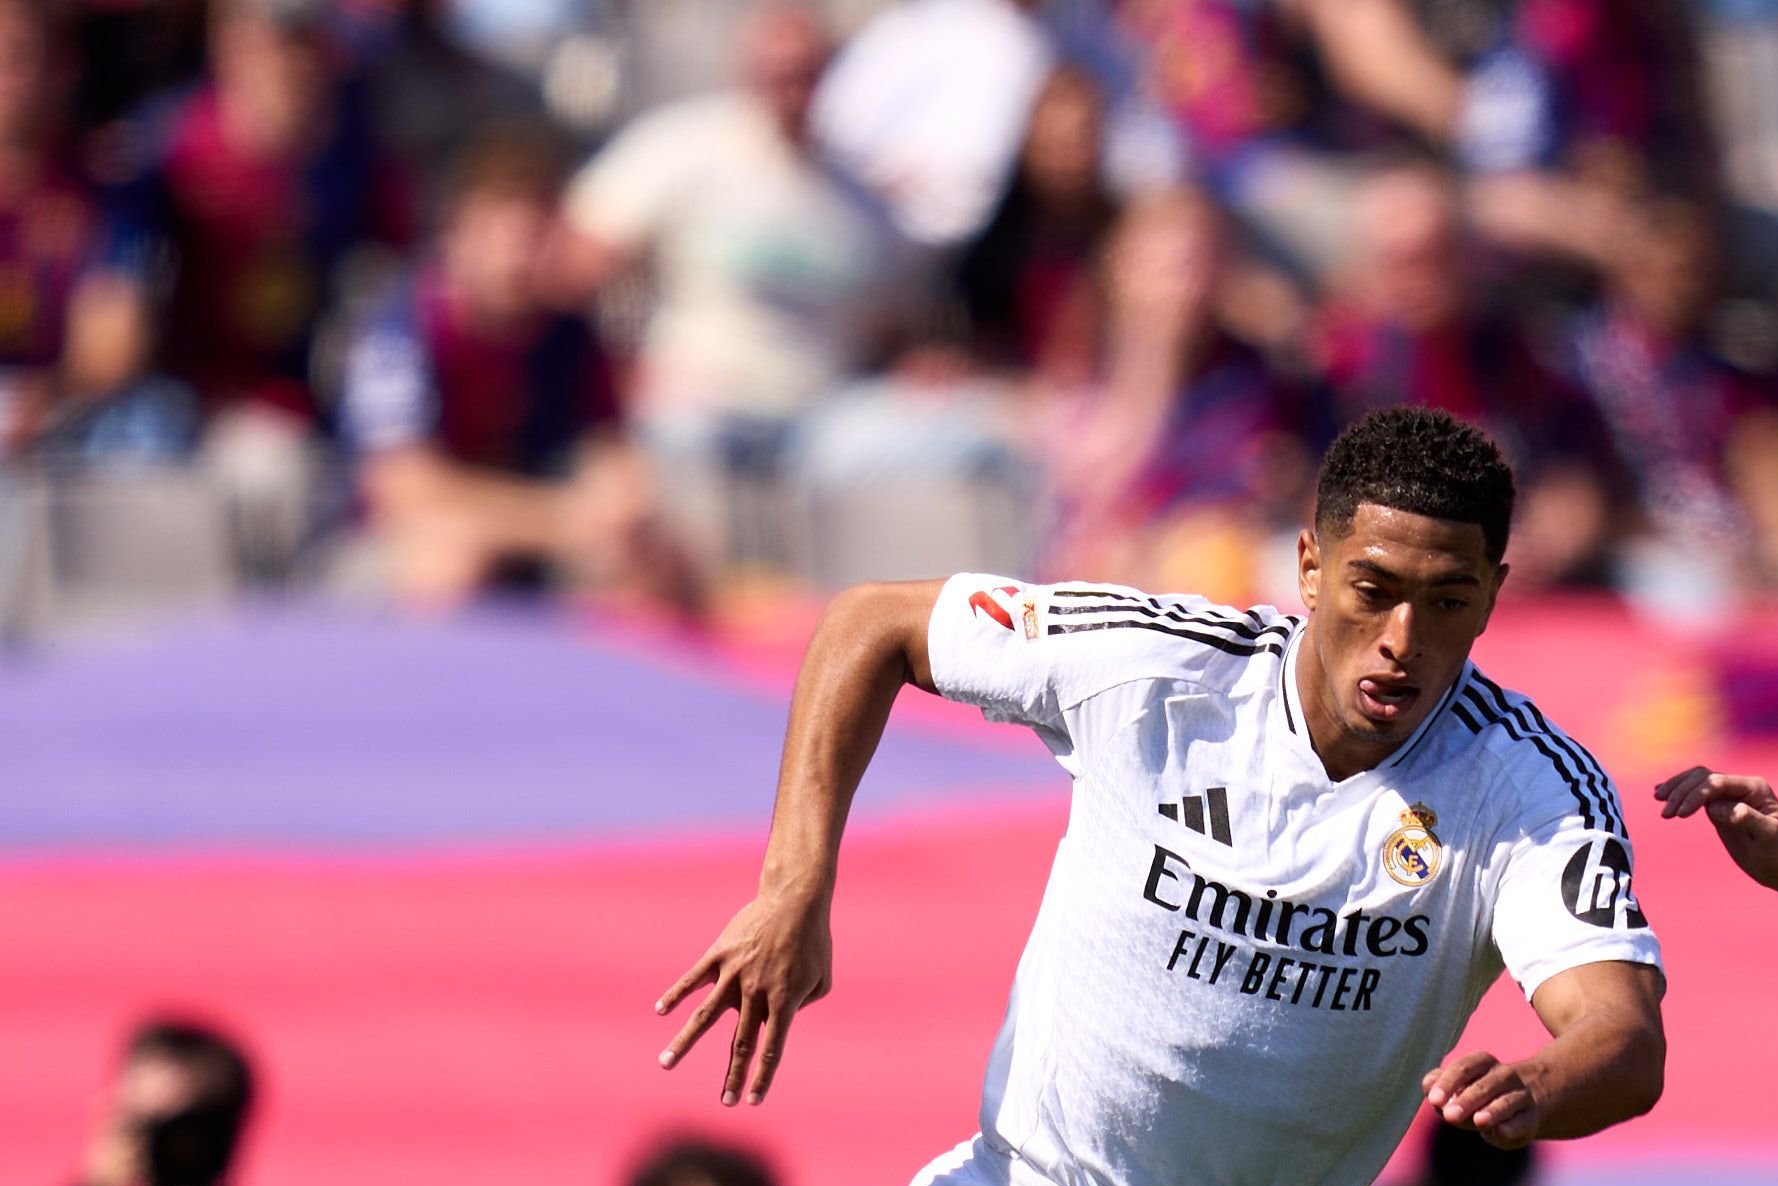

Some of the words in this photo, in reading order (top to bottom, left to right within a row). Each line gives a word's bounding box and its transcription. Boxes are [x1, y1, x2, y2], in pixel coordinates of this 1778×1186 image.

[1143, 844, 1430, 957] Emirates
[1166, 930, 1237, 985] FLY
[1240, 952, 1381, 1011] BETTER
